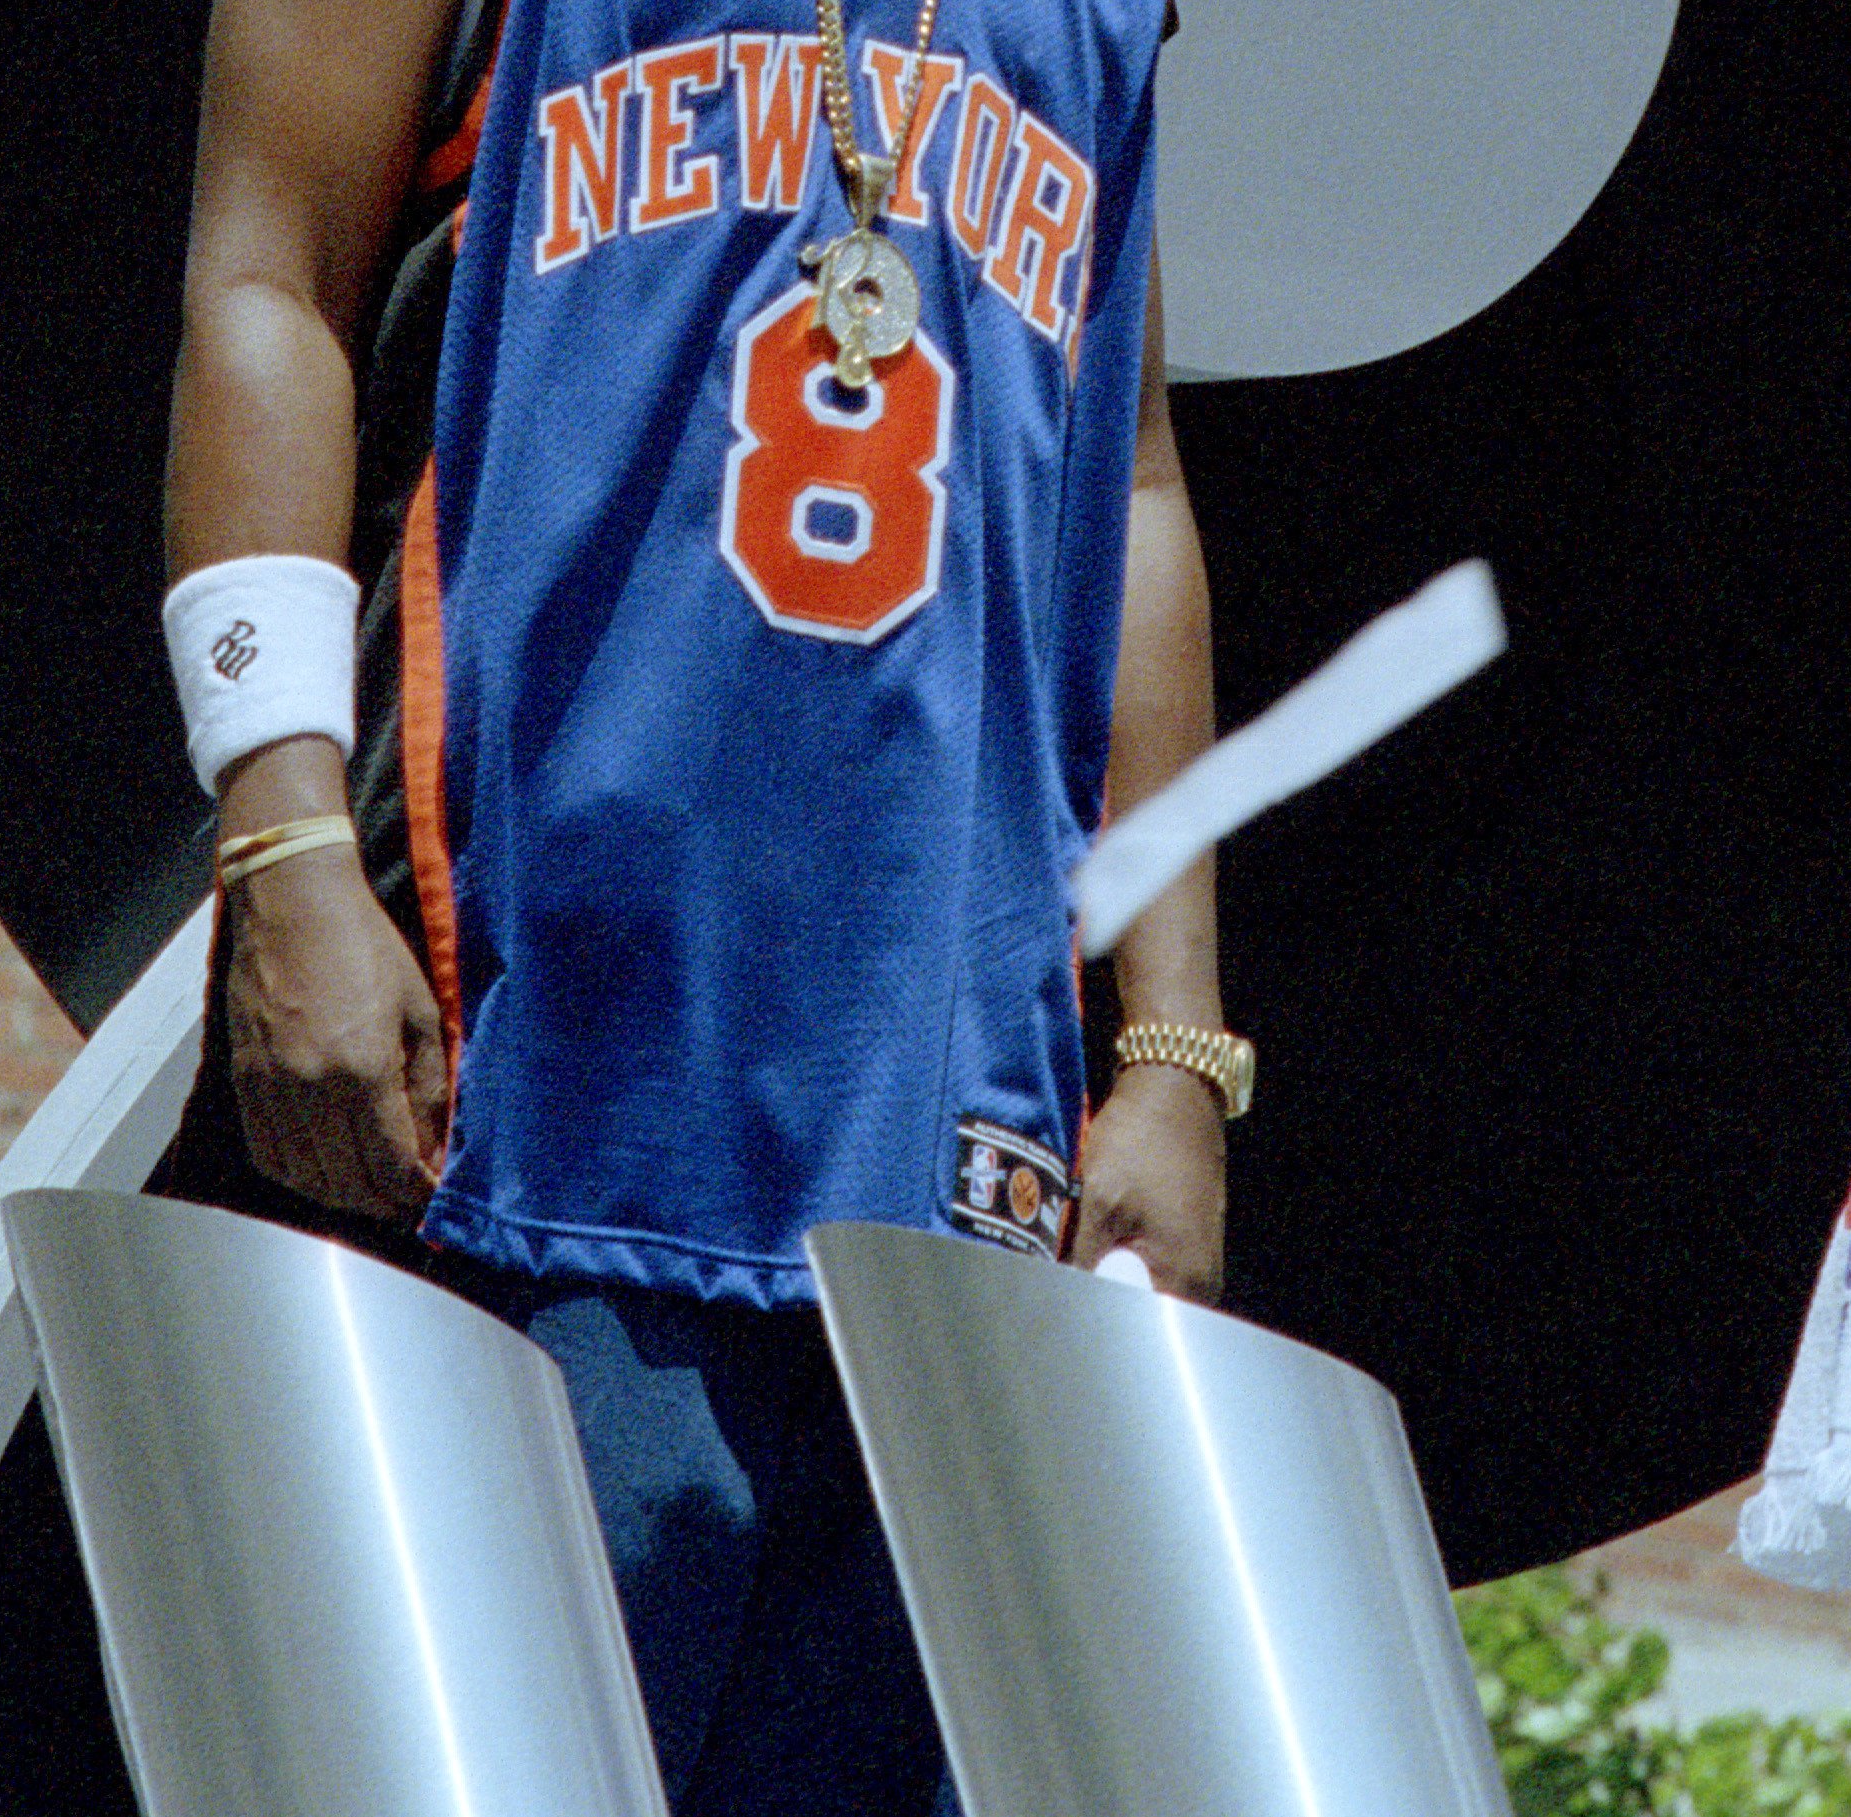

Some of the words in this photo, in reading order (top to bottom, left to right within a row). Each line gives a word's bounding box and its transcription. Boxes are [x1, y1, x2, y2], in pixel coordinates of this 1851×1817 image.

[535, 33, 825, 275] NEW
[862, 38, 1097, 388] YOR
[719, 279, 955, 646] 8
